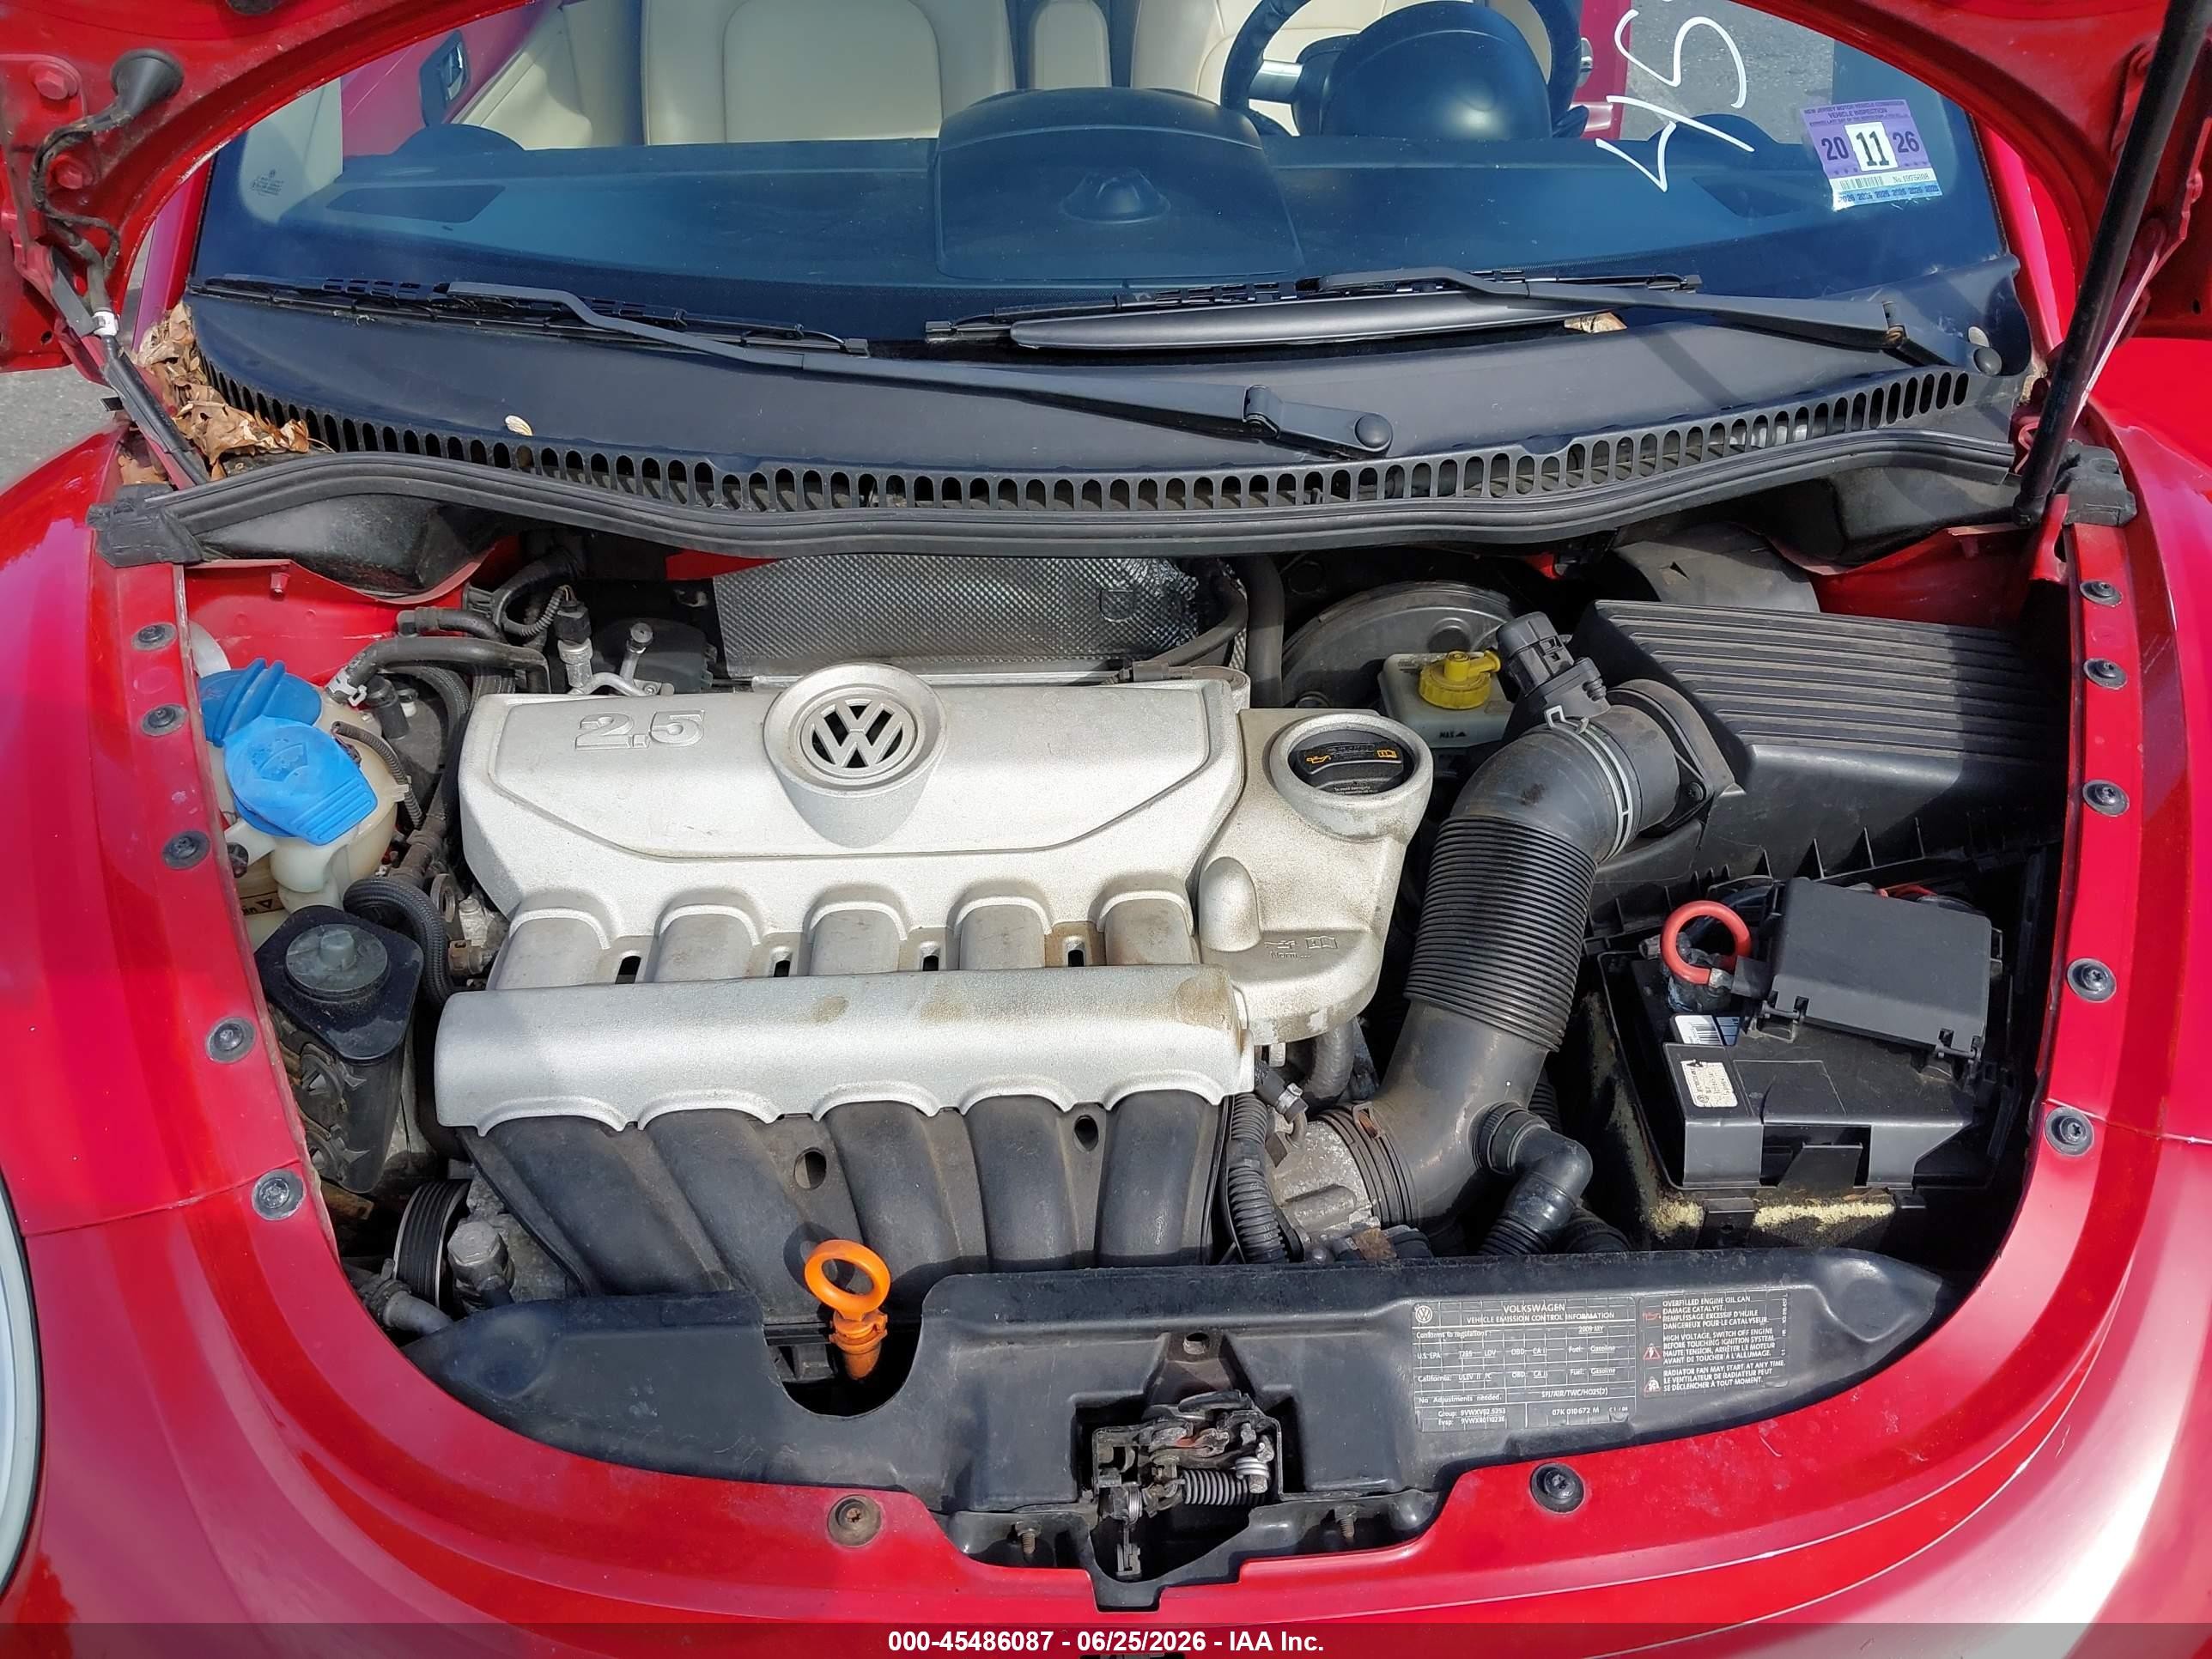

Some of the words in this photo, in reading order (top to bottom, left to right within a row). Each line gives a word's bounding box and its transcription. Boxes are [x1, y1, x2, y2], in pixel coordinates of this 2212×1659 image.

[1821, 137, 1849, 161] 20
[1856, 131, 1889, 166] 11
[1893, 131, 1920, 153] 26
[574, 709, 705, 750] 2.5
[1663, 1298, 1699, 1307] OVERFILLED
[1504, 1304, 1565, 1314] VOLKSWAGEN
[1416, 1330, 1444, 1339] Conforms
[1663, 1341, 1685, 1350] BEFORE
[1686, 1340, 1719, 1348] TOUCHING
[1673, 1375, 1712, 1383] VENTILATEUR
[1723, 1370, 1756, 1379] RADIATEUR
[1432, 1395, 1473, 1403] Adjustments
[1437, 1409, 1457, 1419] Group:
